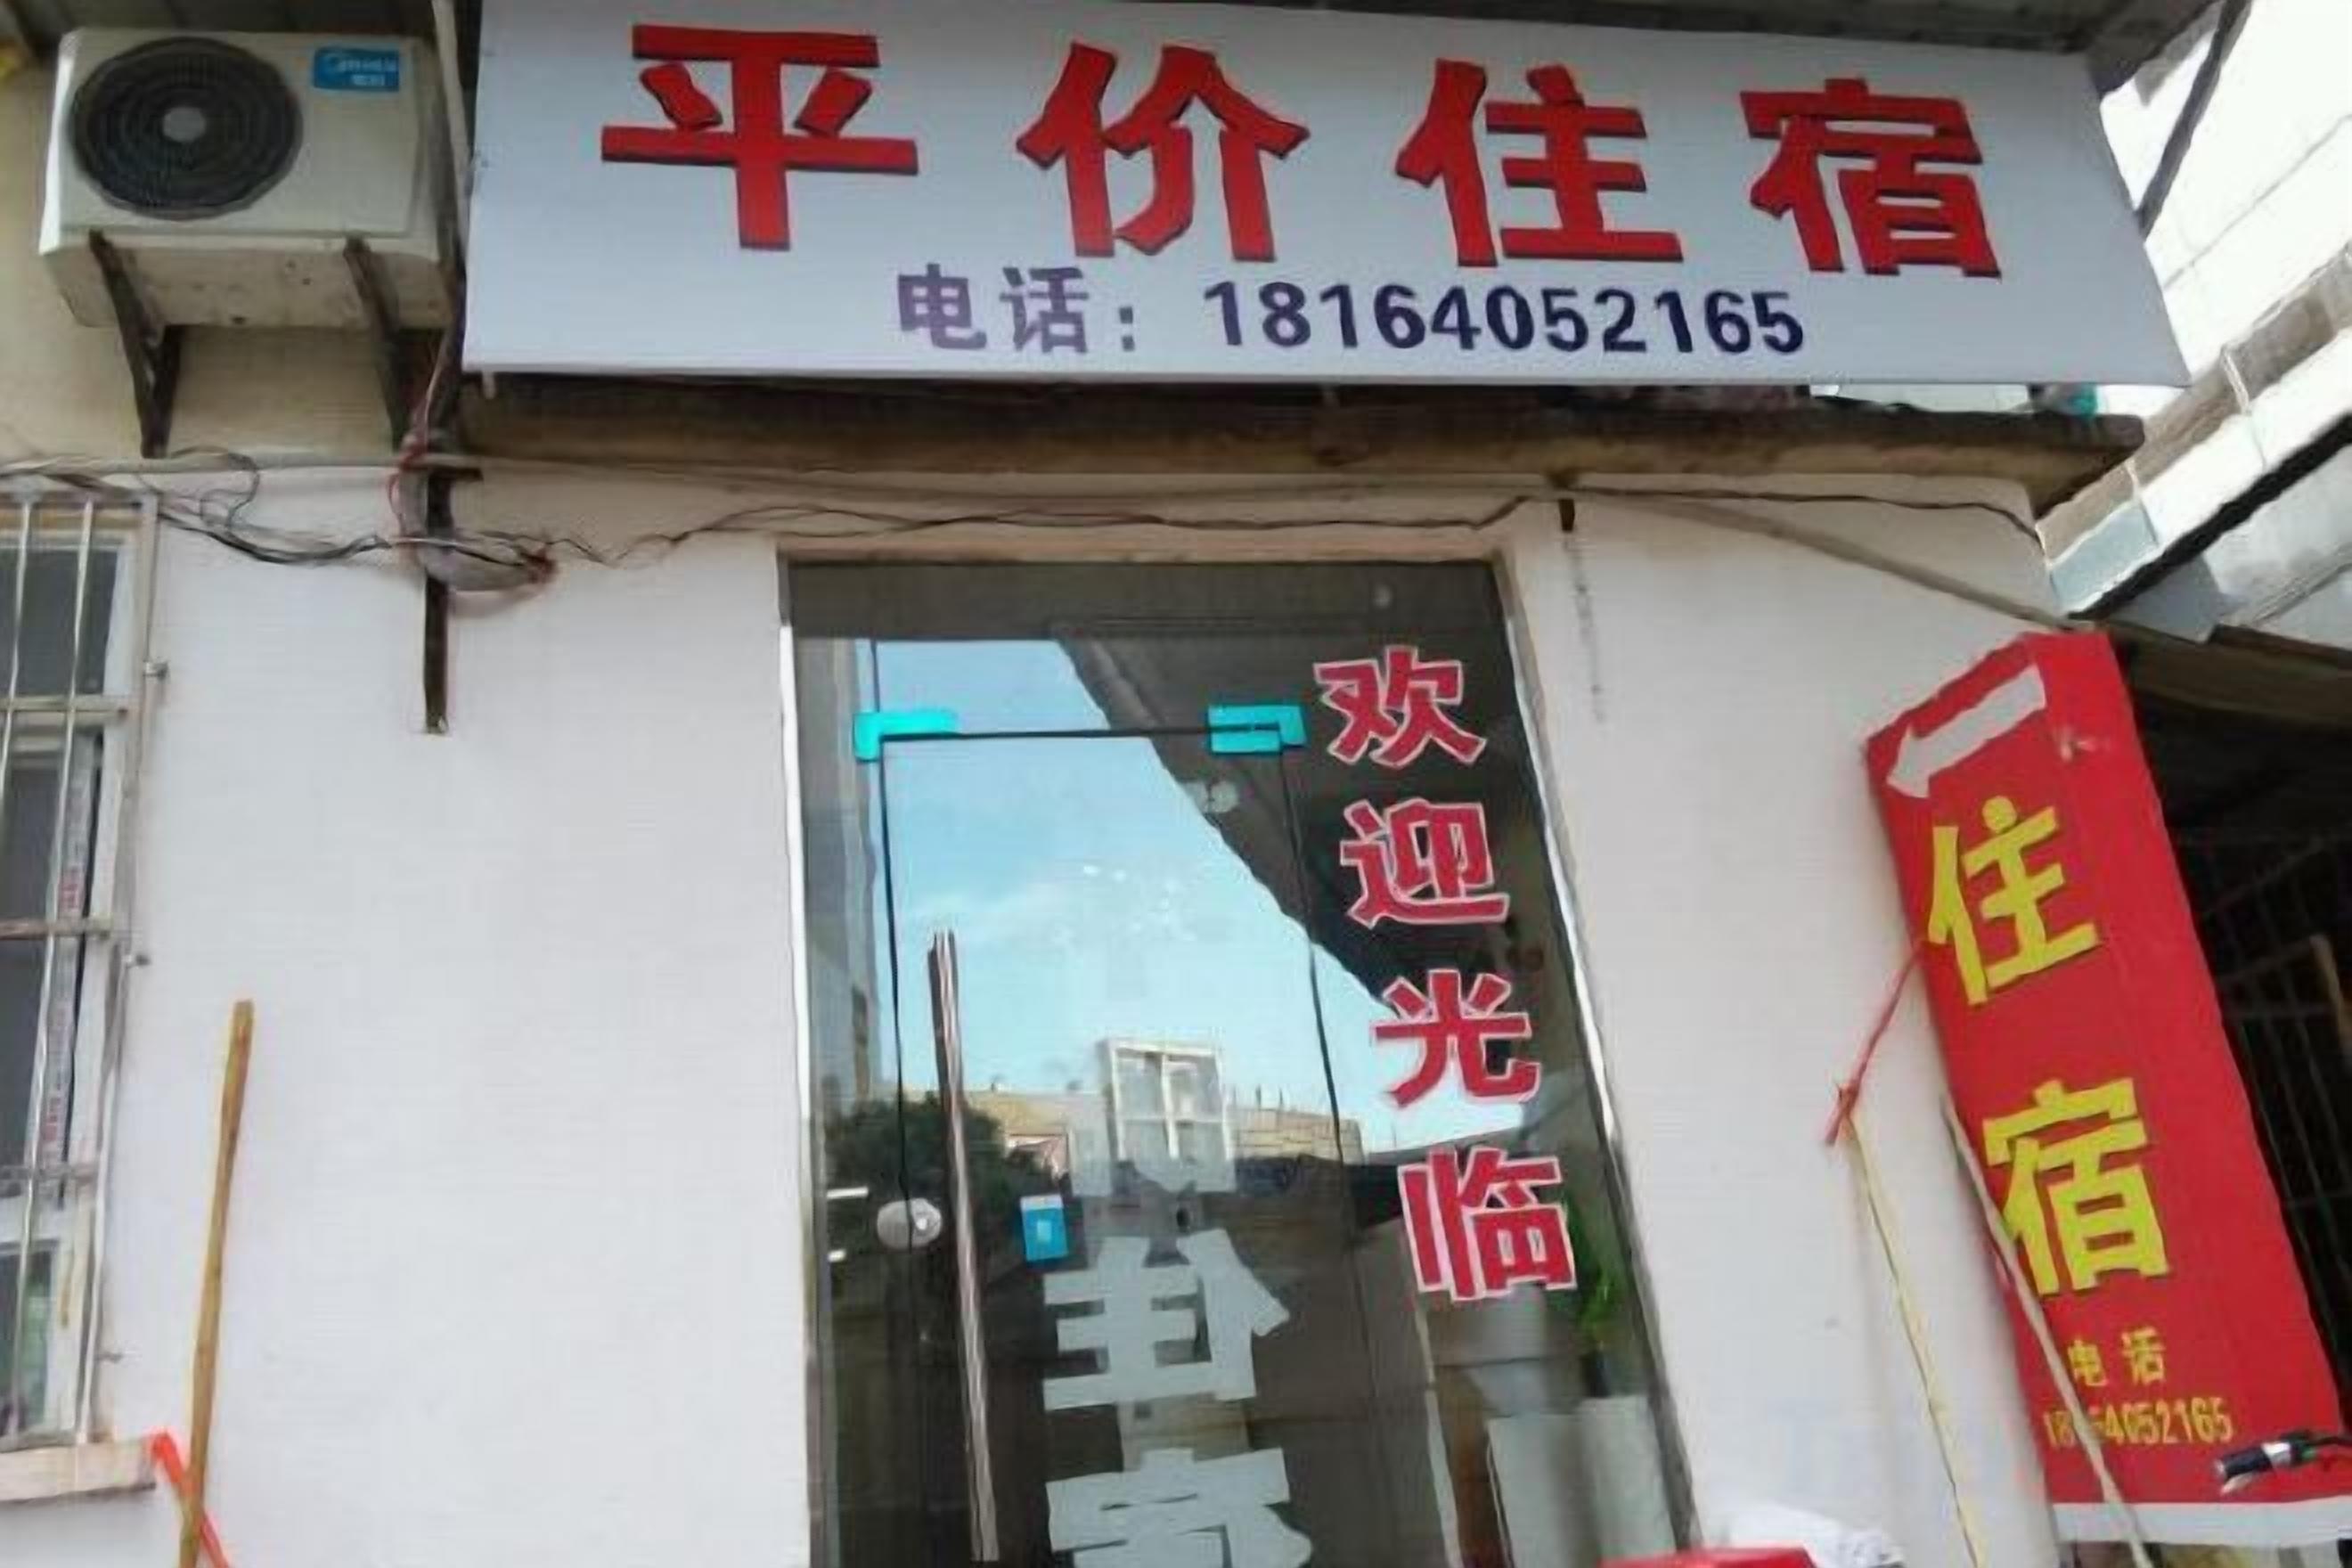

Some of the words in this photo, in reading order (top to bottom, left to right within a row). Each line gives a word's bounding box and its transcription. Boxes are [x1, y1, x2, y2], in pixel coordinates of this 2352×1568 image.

[601, 24, 2001, 277] 平价住宿
[1204, 281, 1804, 354] 18164052165
[1313, 646, 1578, 1302] 欢迎光临
[1927, 796, 2172, 1296] 住宿
[2043, 1396, 2234, 1449] 184052165
[2067, 1326, 2165, 1387] 电话
